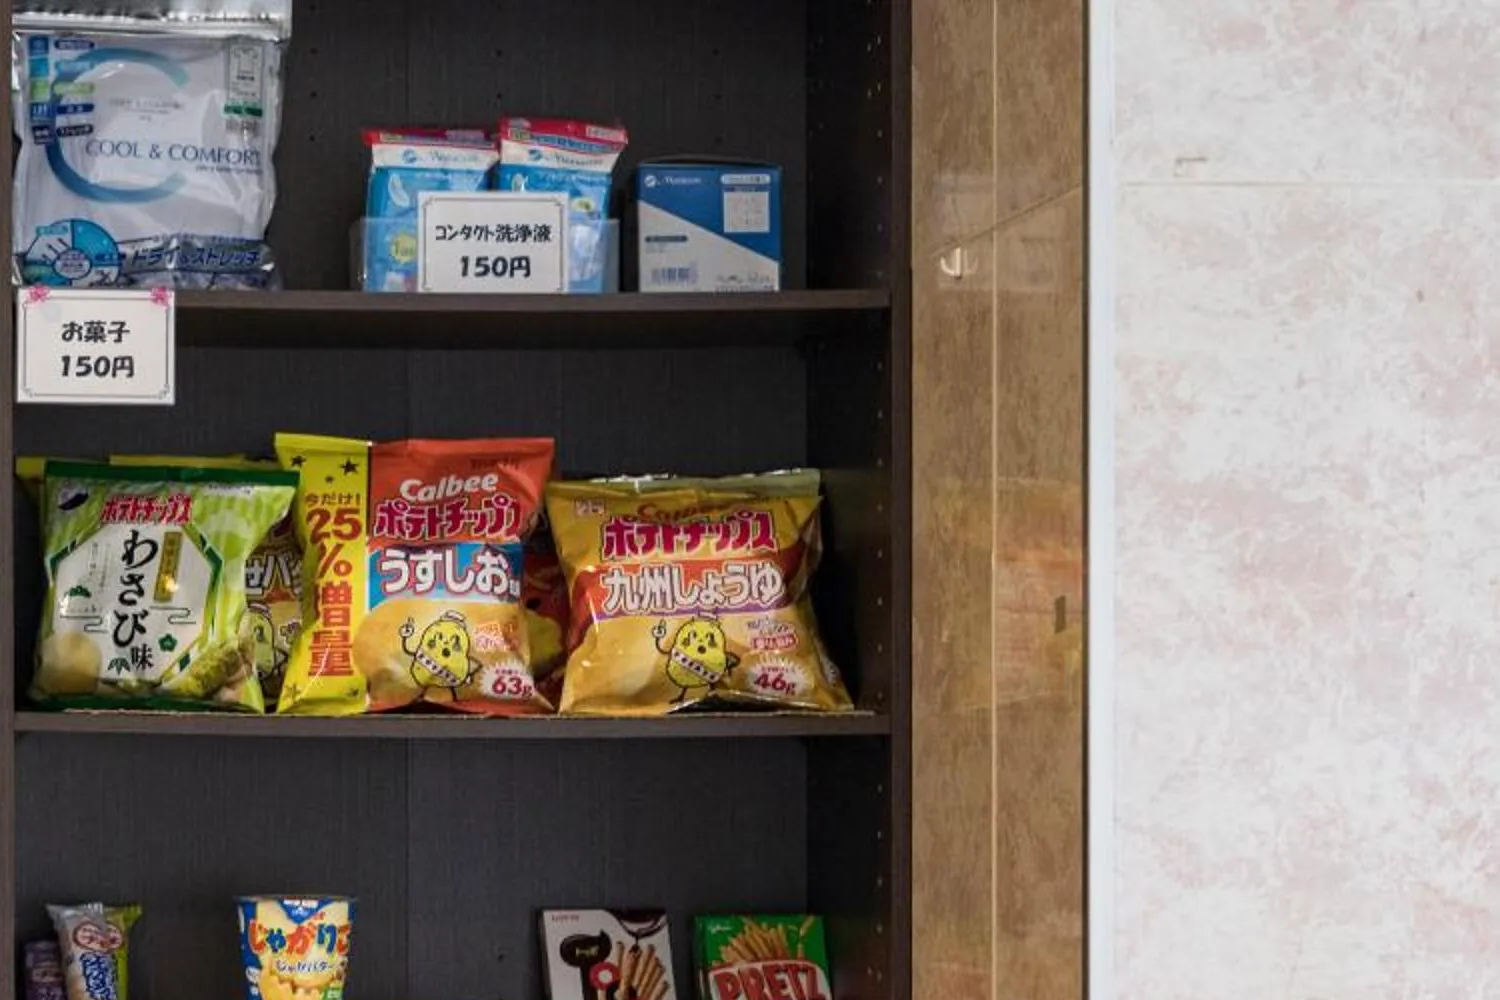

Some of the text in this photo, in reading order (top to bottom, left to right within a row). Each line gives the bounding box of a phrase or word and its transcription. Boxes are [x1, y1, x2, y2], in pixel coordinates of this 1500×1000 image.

[168, 143, 261, 166] COMFORT
[435, 223, 553, 243] コンタクト洗浄液
[460, 255, 532, 279] 150円
[61, 320, 131, 344] お菓子
[61, 355, 135, 379] 150円
[400, 472, 499, 502] Calbee
[601, 510, 778, 559] ポテトチップス
[600, 562, 786, 613] 九州しょうゆ
